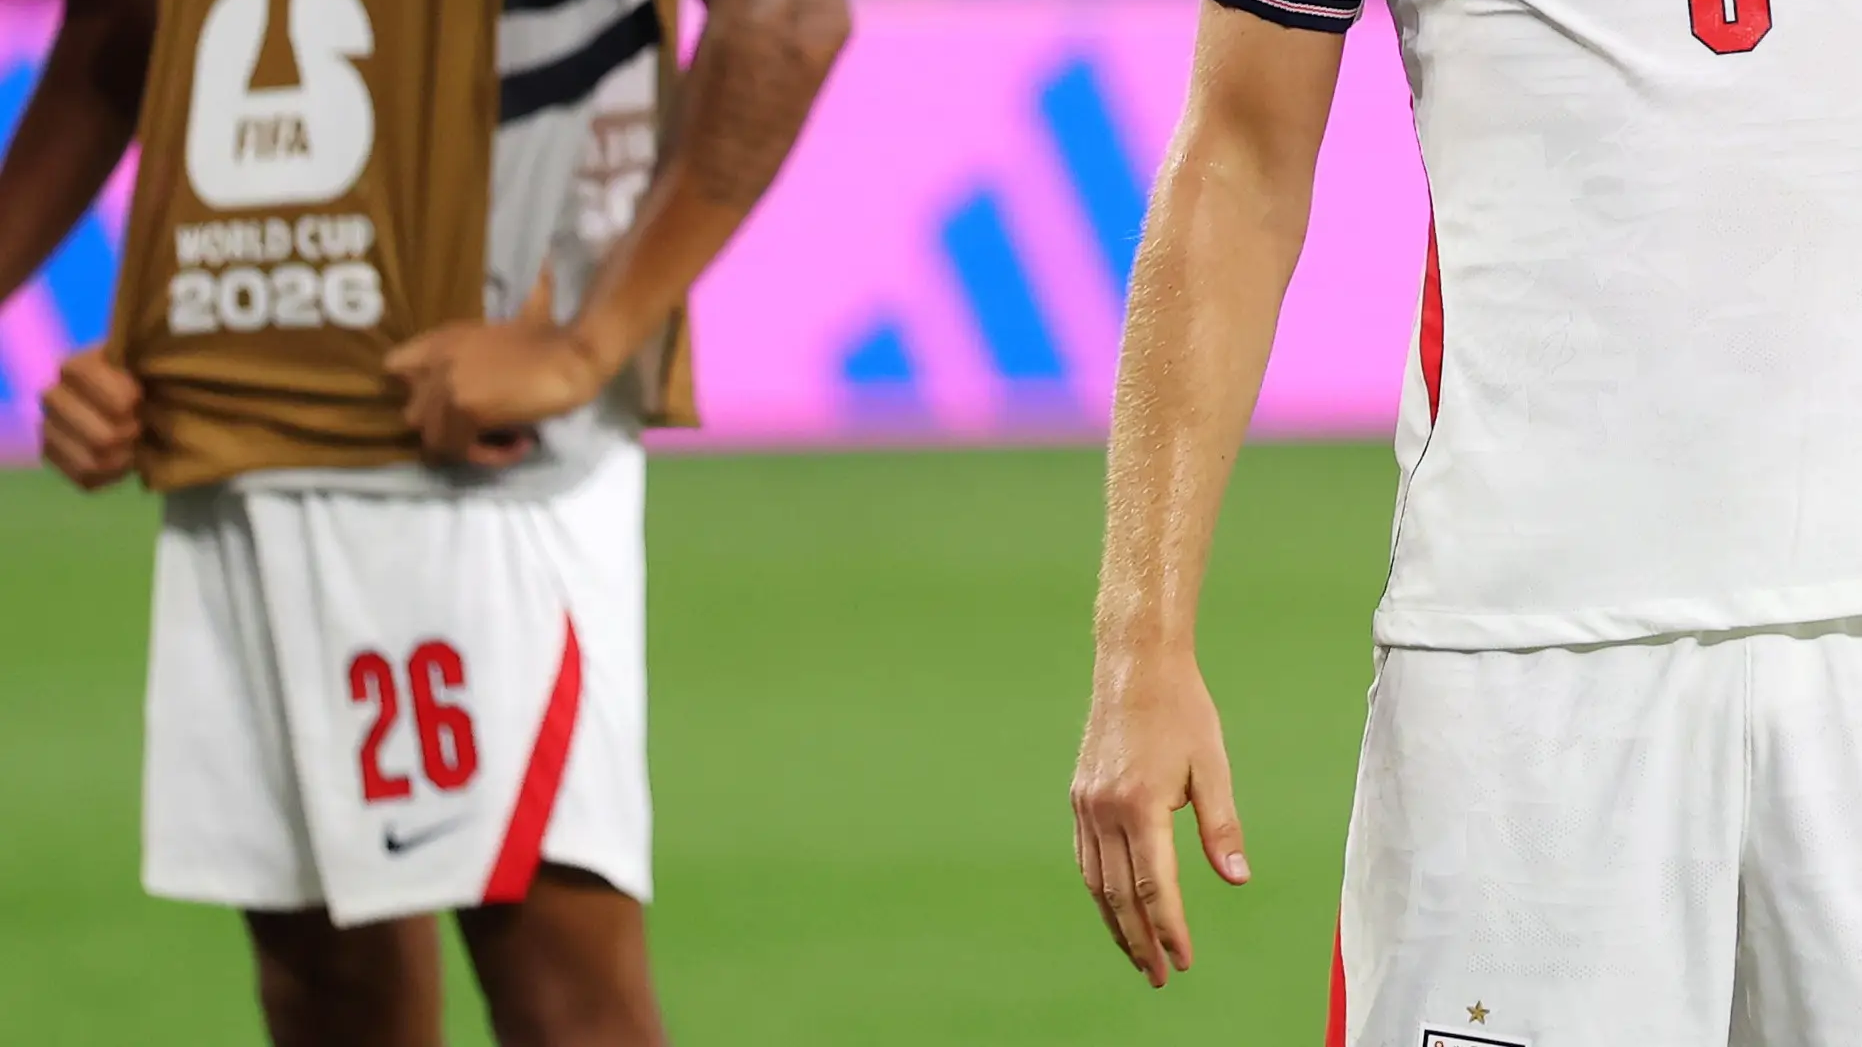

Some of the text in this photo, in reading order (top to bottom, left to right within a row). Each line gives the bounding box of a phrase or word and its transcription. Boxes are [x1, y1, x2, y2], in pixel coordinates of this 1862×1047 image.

[233, 115, 312, 164] FIFA
[175, 214, 376, 267] WORLD CUP
[168, 262, 385, 335] 2026
[348, 639, 478, 803] 26
